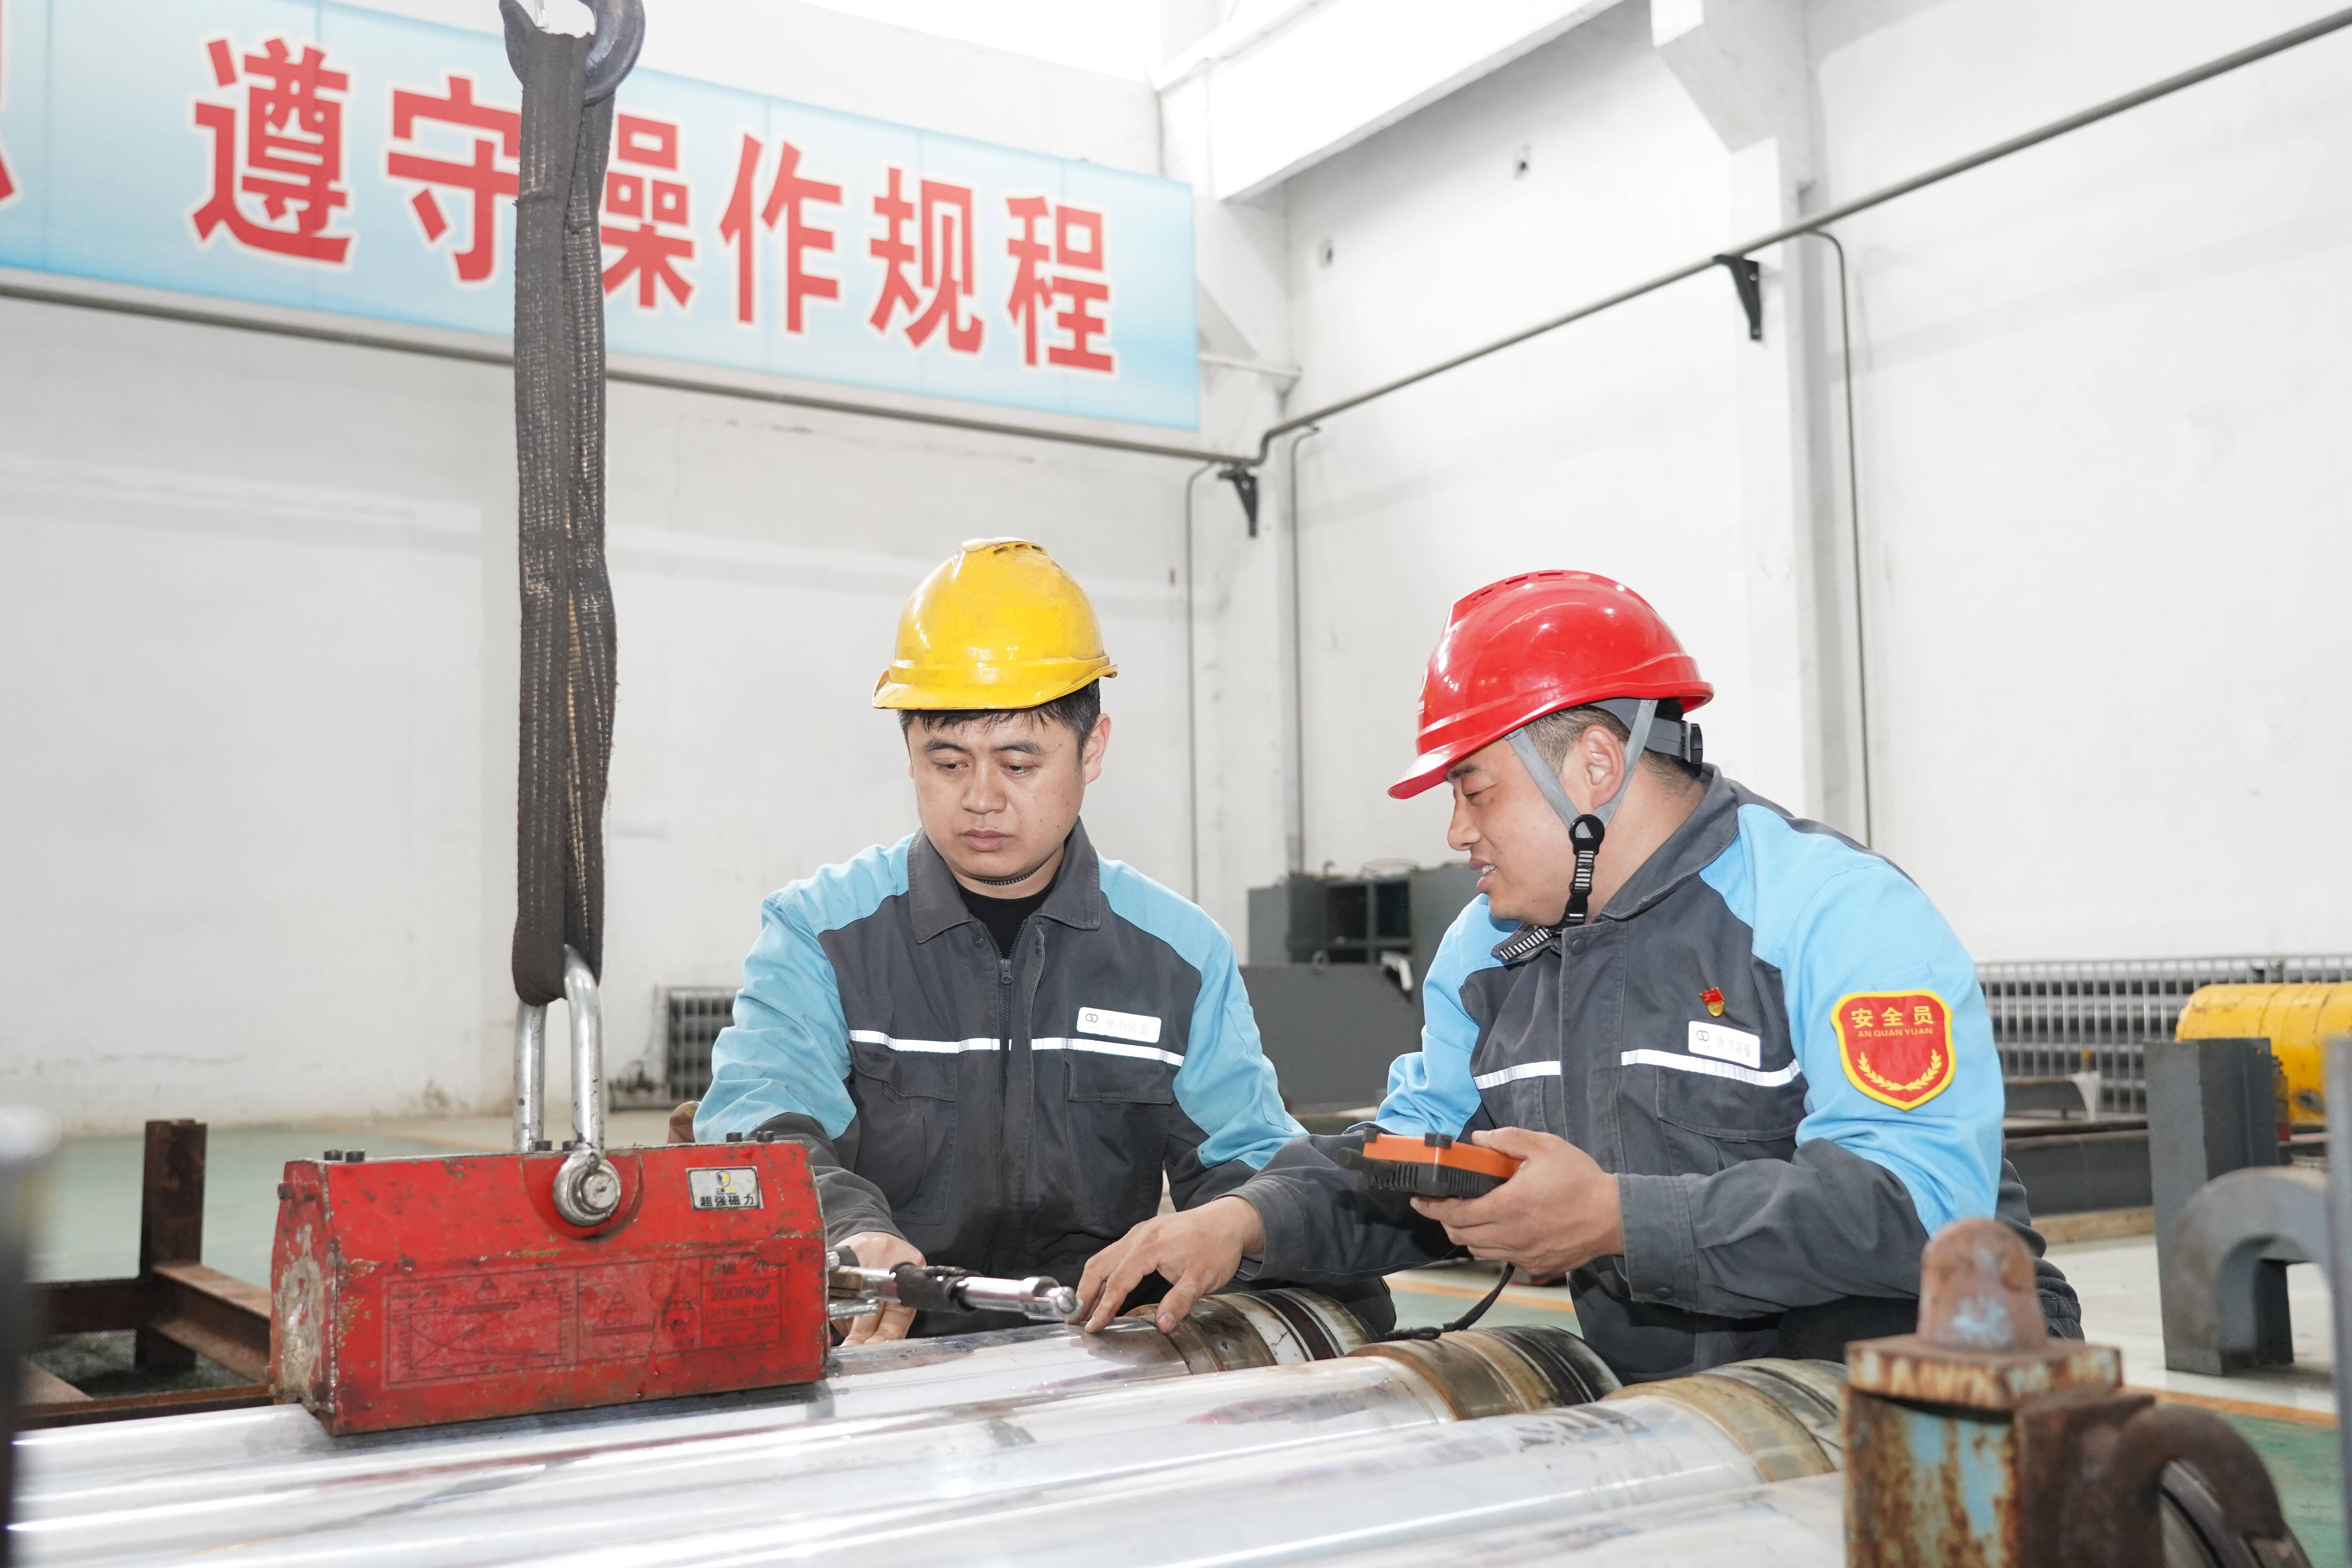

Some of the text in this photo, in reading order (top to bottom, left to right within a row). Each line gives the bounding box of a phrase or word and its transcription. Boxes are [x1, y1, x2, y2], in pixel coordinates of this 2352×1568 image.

[192, 38, 1114, 374] 遵守操作规程
[1851, 1005, 1934, 1029] 安全员
[700, 1193, 754, 1207] 超强磁力
[710, 1283, 770, 1302] 2000kgf
